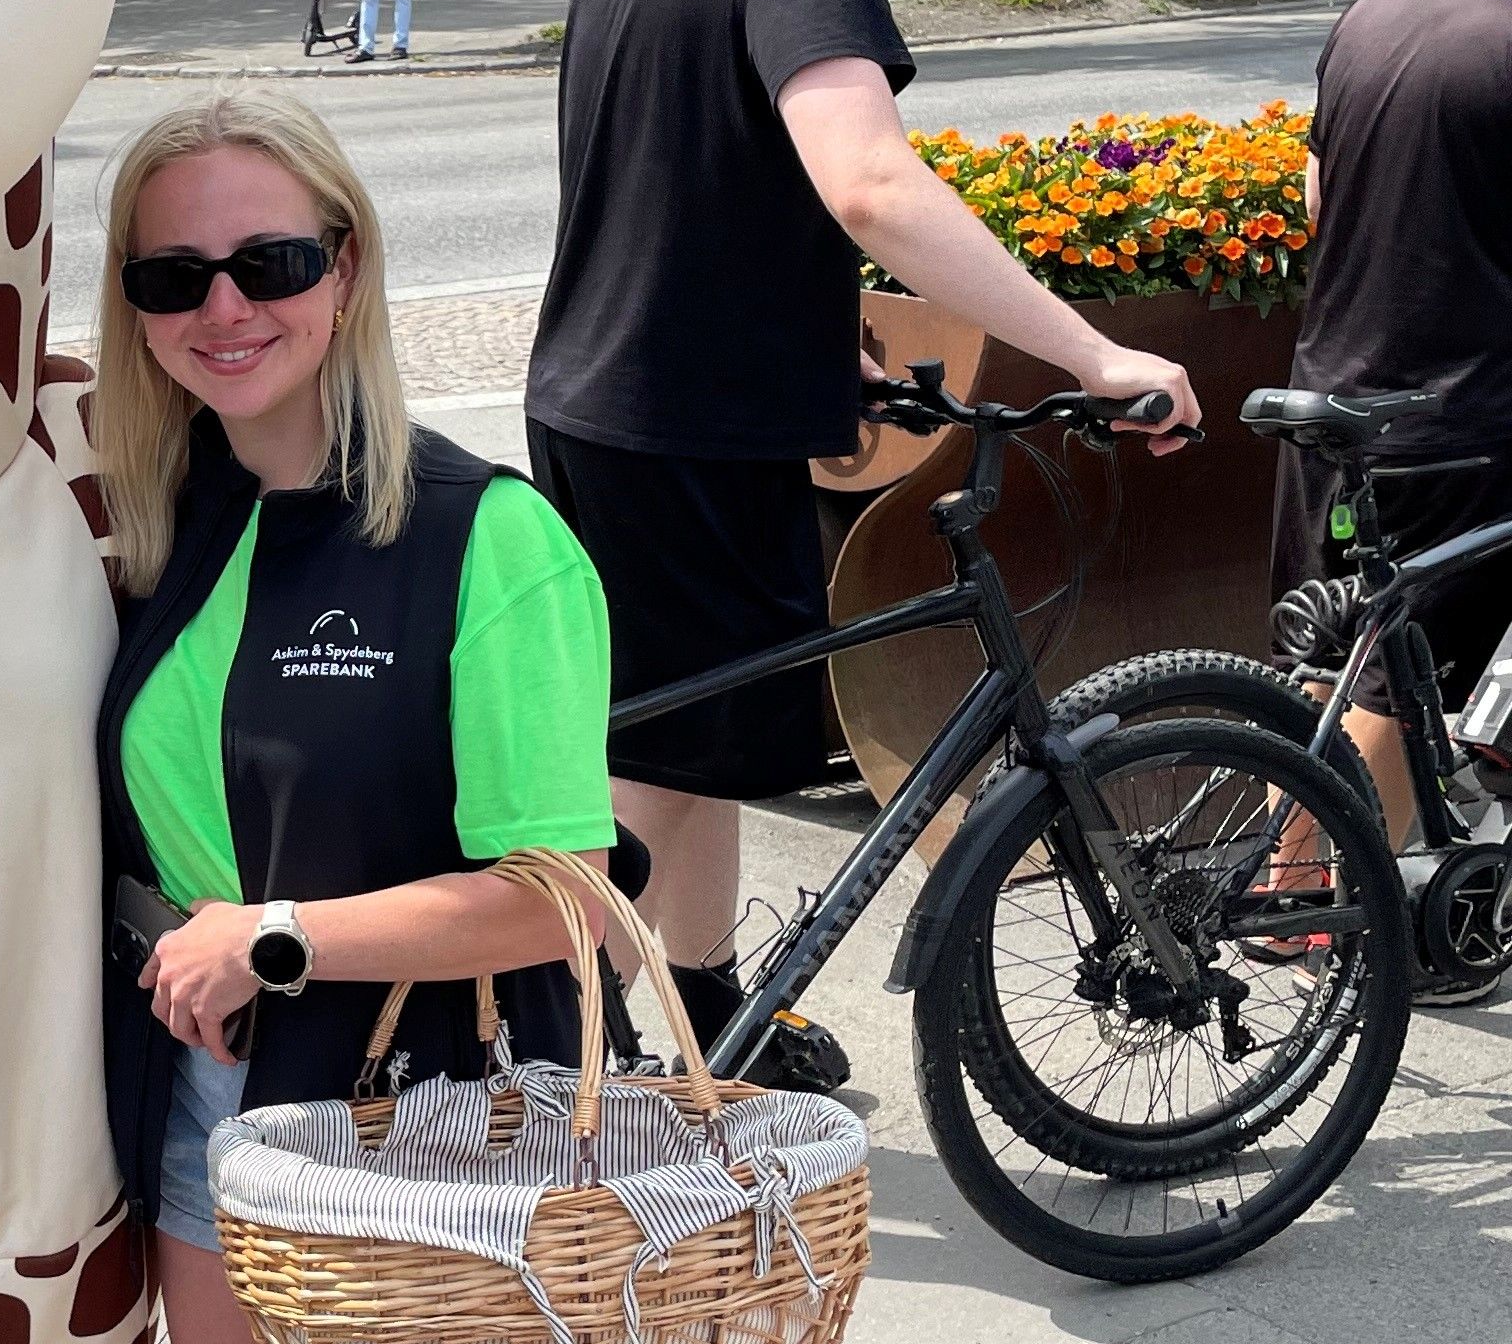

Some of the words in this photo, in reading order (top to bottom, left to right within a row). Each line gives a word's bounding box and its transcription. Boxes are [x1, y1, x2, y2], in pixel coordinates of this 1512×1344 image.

[271, 646, 309, 661] Askim
[311, 644, 322, 656] &
[325, 643, 394, 664] Spydeberg
[282, 662, 376, 679] SPAREBANK
[778, 783, 936, 1008] DIAMANT
